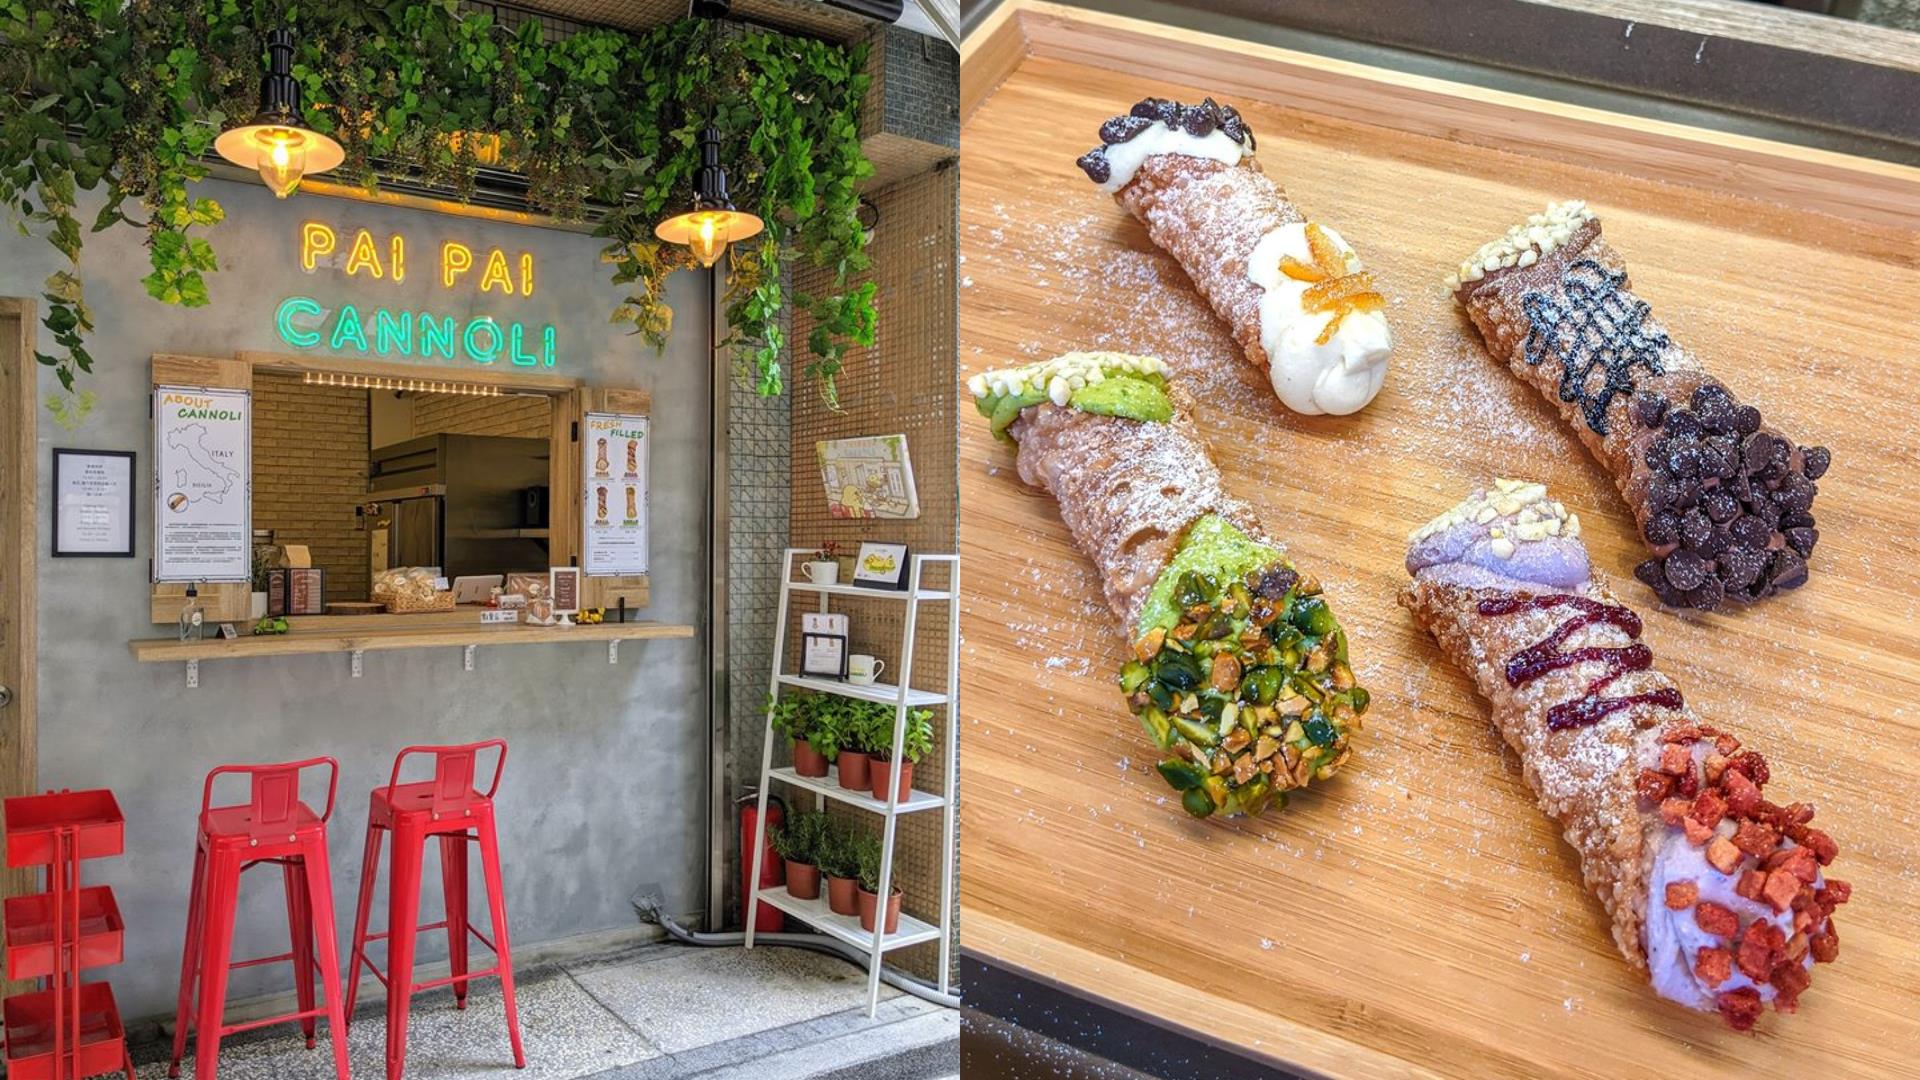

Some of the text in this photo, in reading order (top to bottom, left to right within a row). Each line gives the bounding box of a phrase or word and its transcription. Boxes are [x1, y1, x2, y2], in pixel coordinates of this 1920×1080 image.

[302, 223, 534, 297] PAI PAI
[276, 296, 556, 368] CANNOLI
[164, 394, 214, 409] ABOUT
[178, 408, 242, 421] CANNOLI
[591, 420, 622, 431] FRESH
[610, 429, 644, 439] FILLED
[211, 450, 234, 458] ITALY
